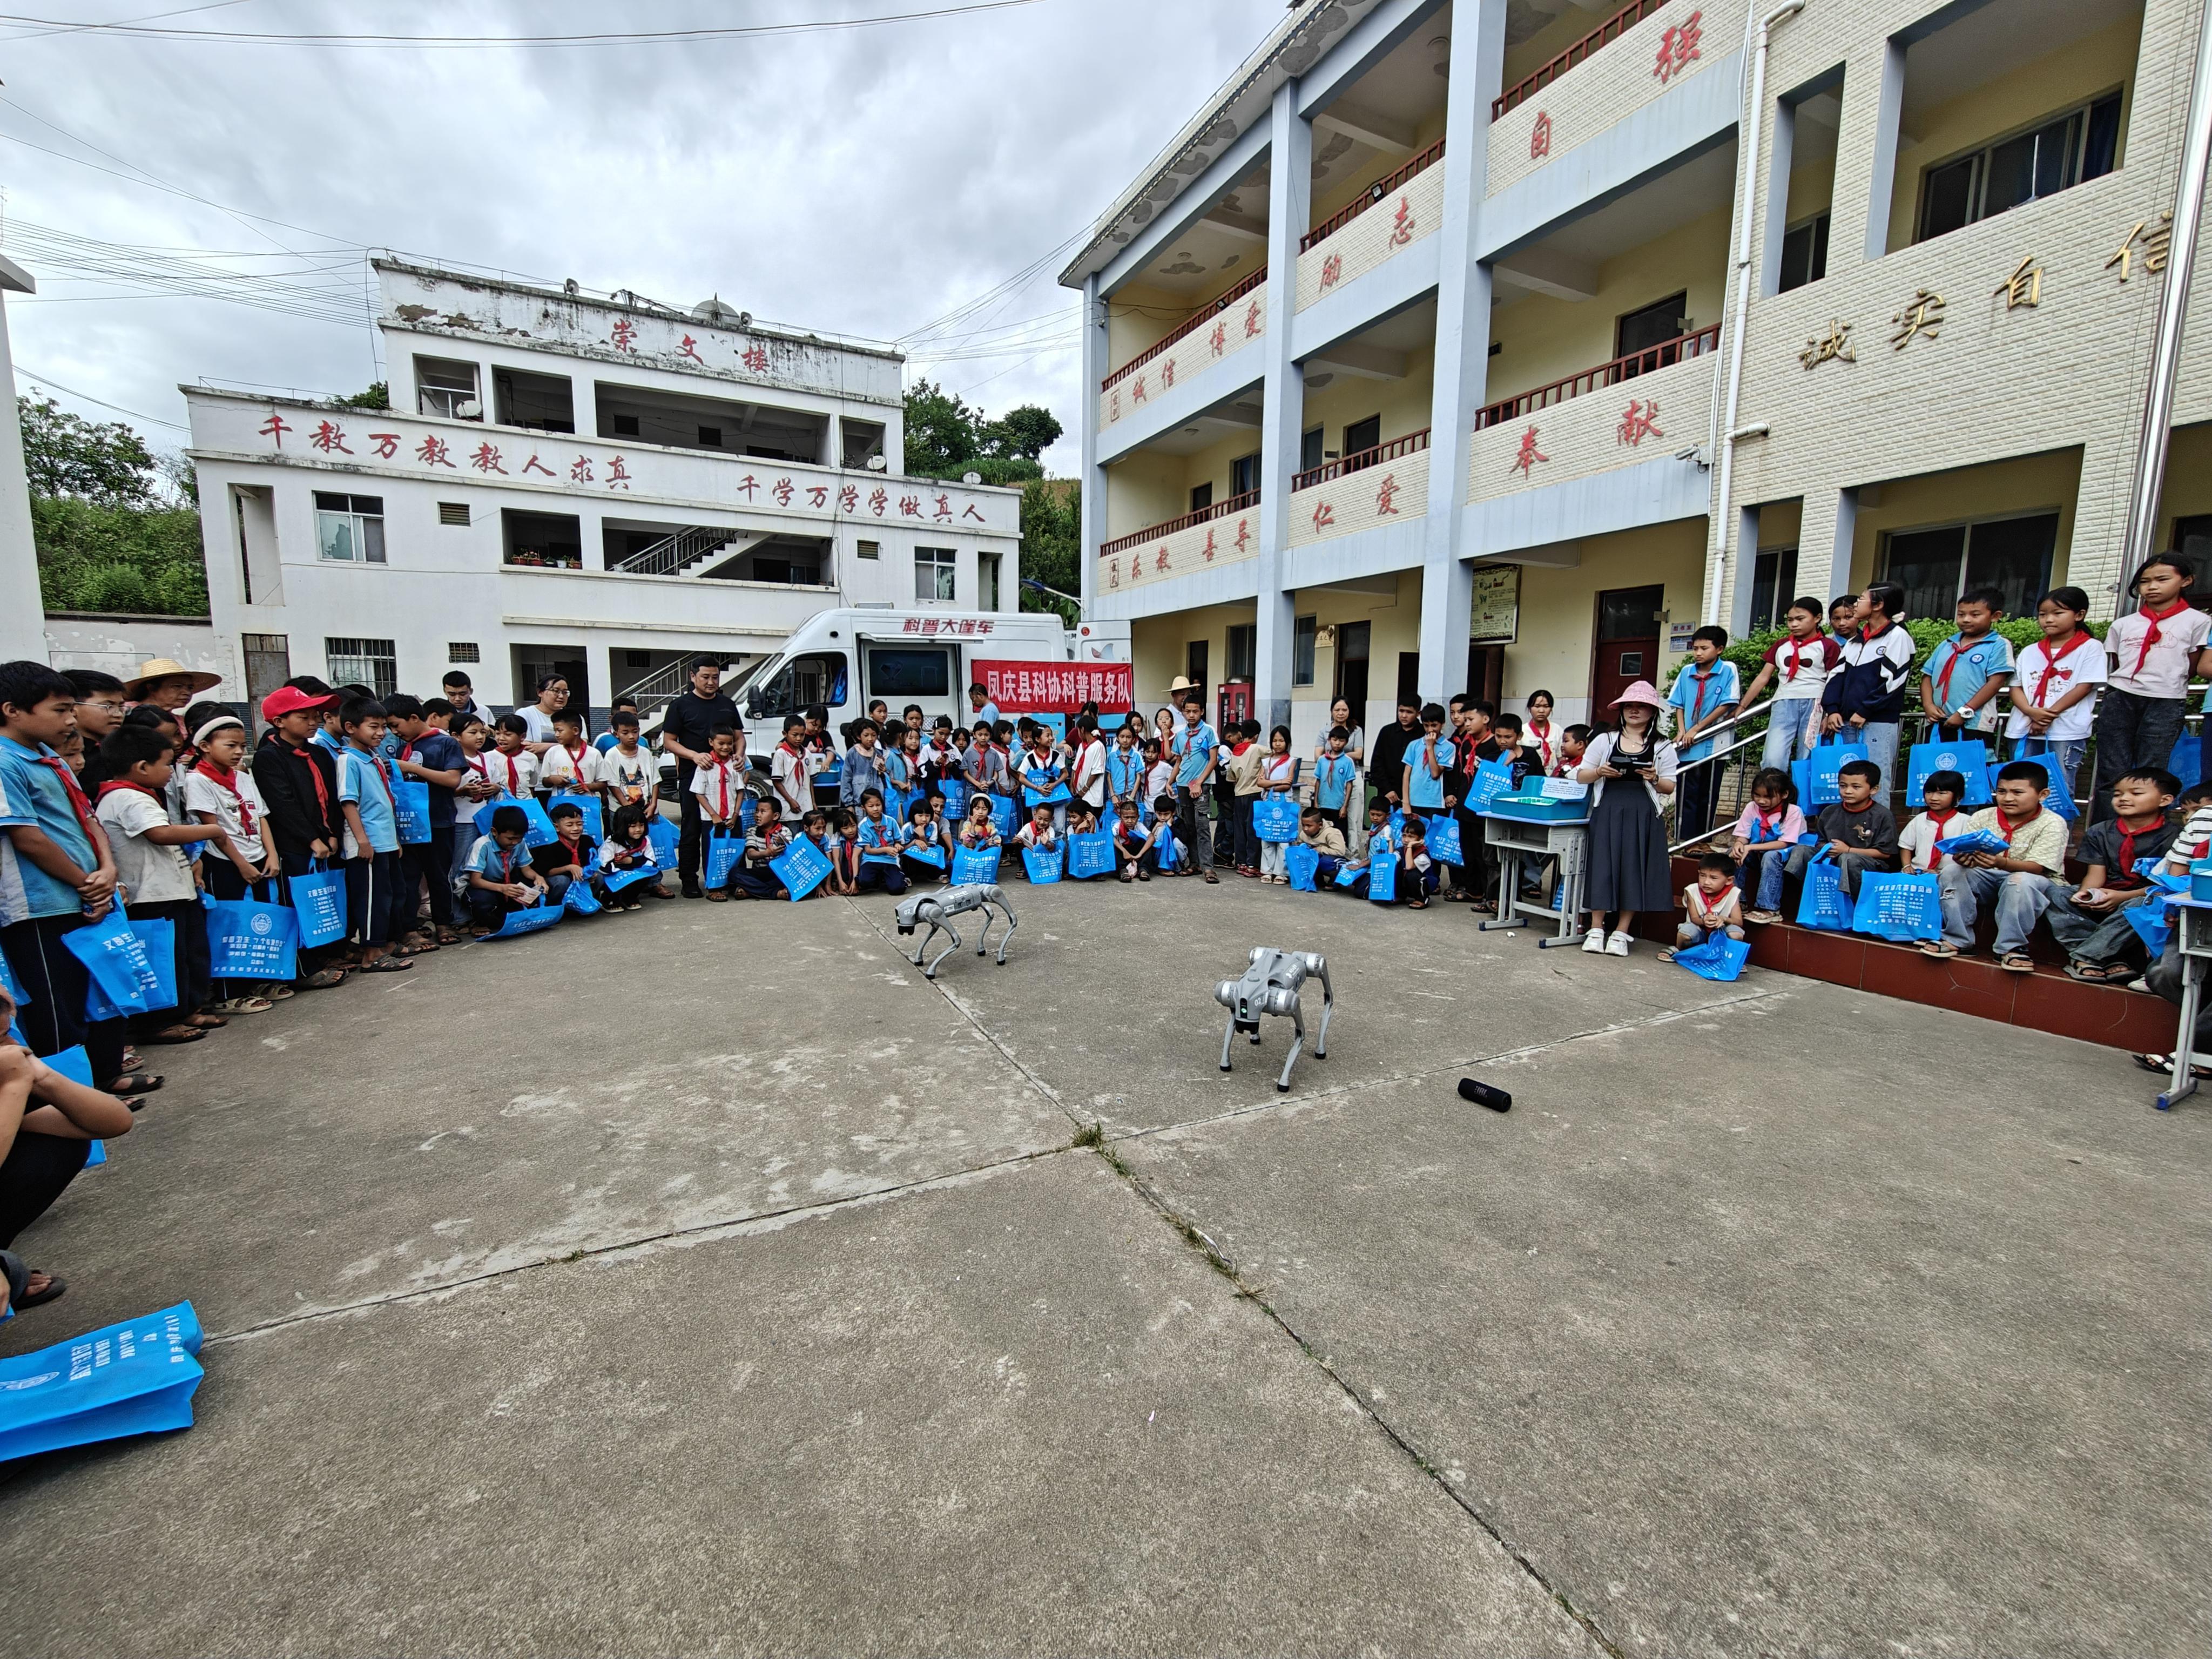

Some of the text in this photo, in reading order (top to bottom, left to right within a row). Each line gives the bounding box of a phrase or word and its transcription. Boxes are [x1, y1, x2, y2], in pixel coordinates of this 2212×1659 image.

[1210, 300, 1262, 358] 博爱
[1319, 196, 1415, 293] 励志
[1530, 10, 1703, 159] 自强
[611, 318, 770, 374] 崇文楼
[258, 415, 632, 490] 千教万教教人求真
[1312, 473, 1400, 534] 仁爱
[1509, 399, 1665, 480] 奉献
[736, 474, 986, 524] 千学万学学做真人
[902, 618, 995, 634] 科普大篷车
[987, 670, 1131, 704] 凤庆县科协科普服务队
[1254, 997, 1262, 1006] 02
[1475, 1086, 1487, 1097] JBL
